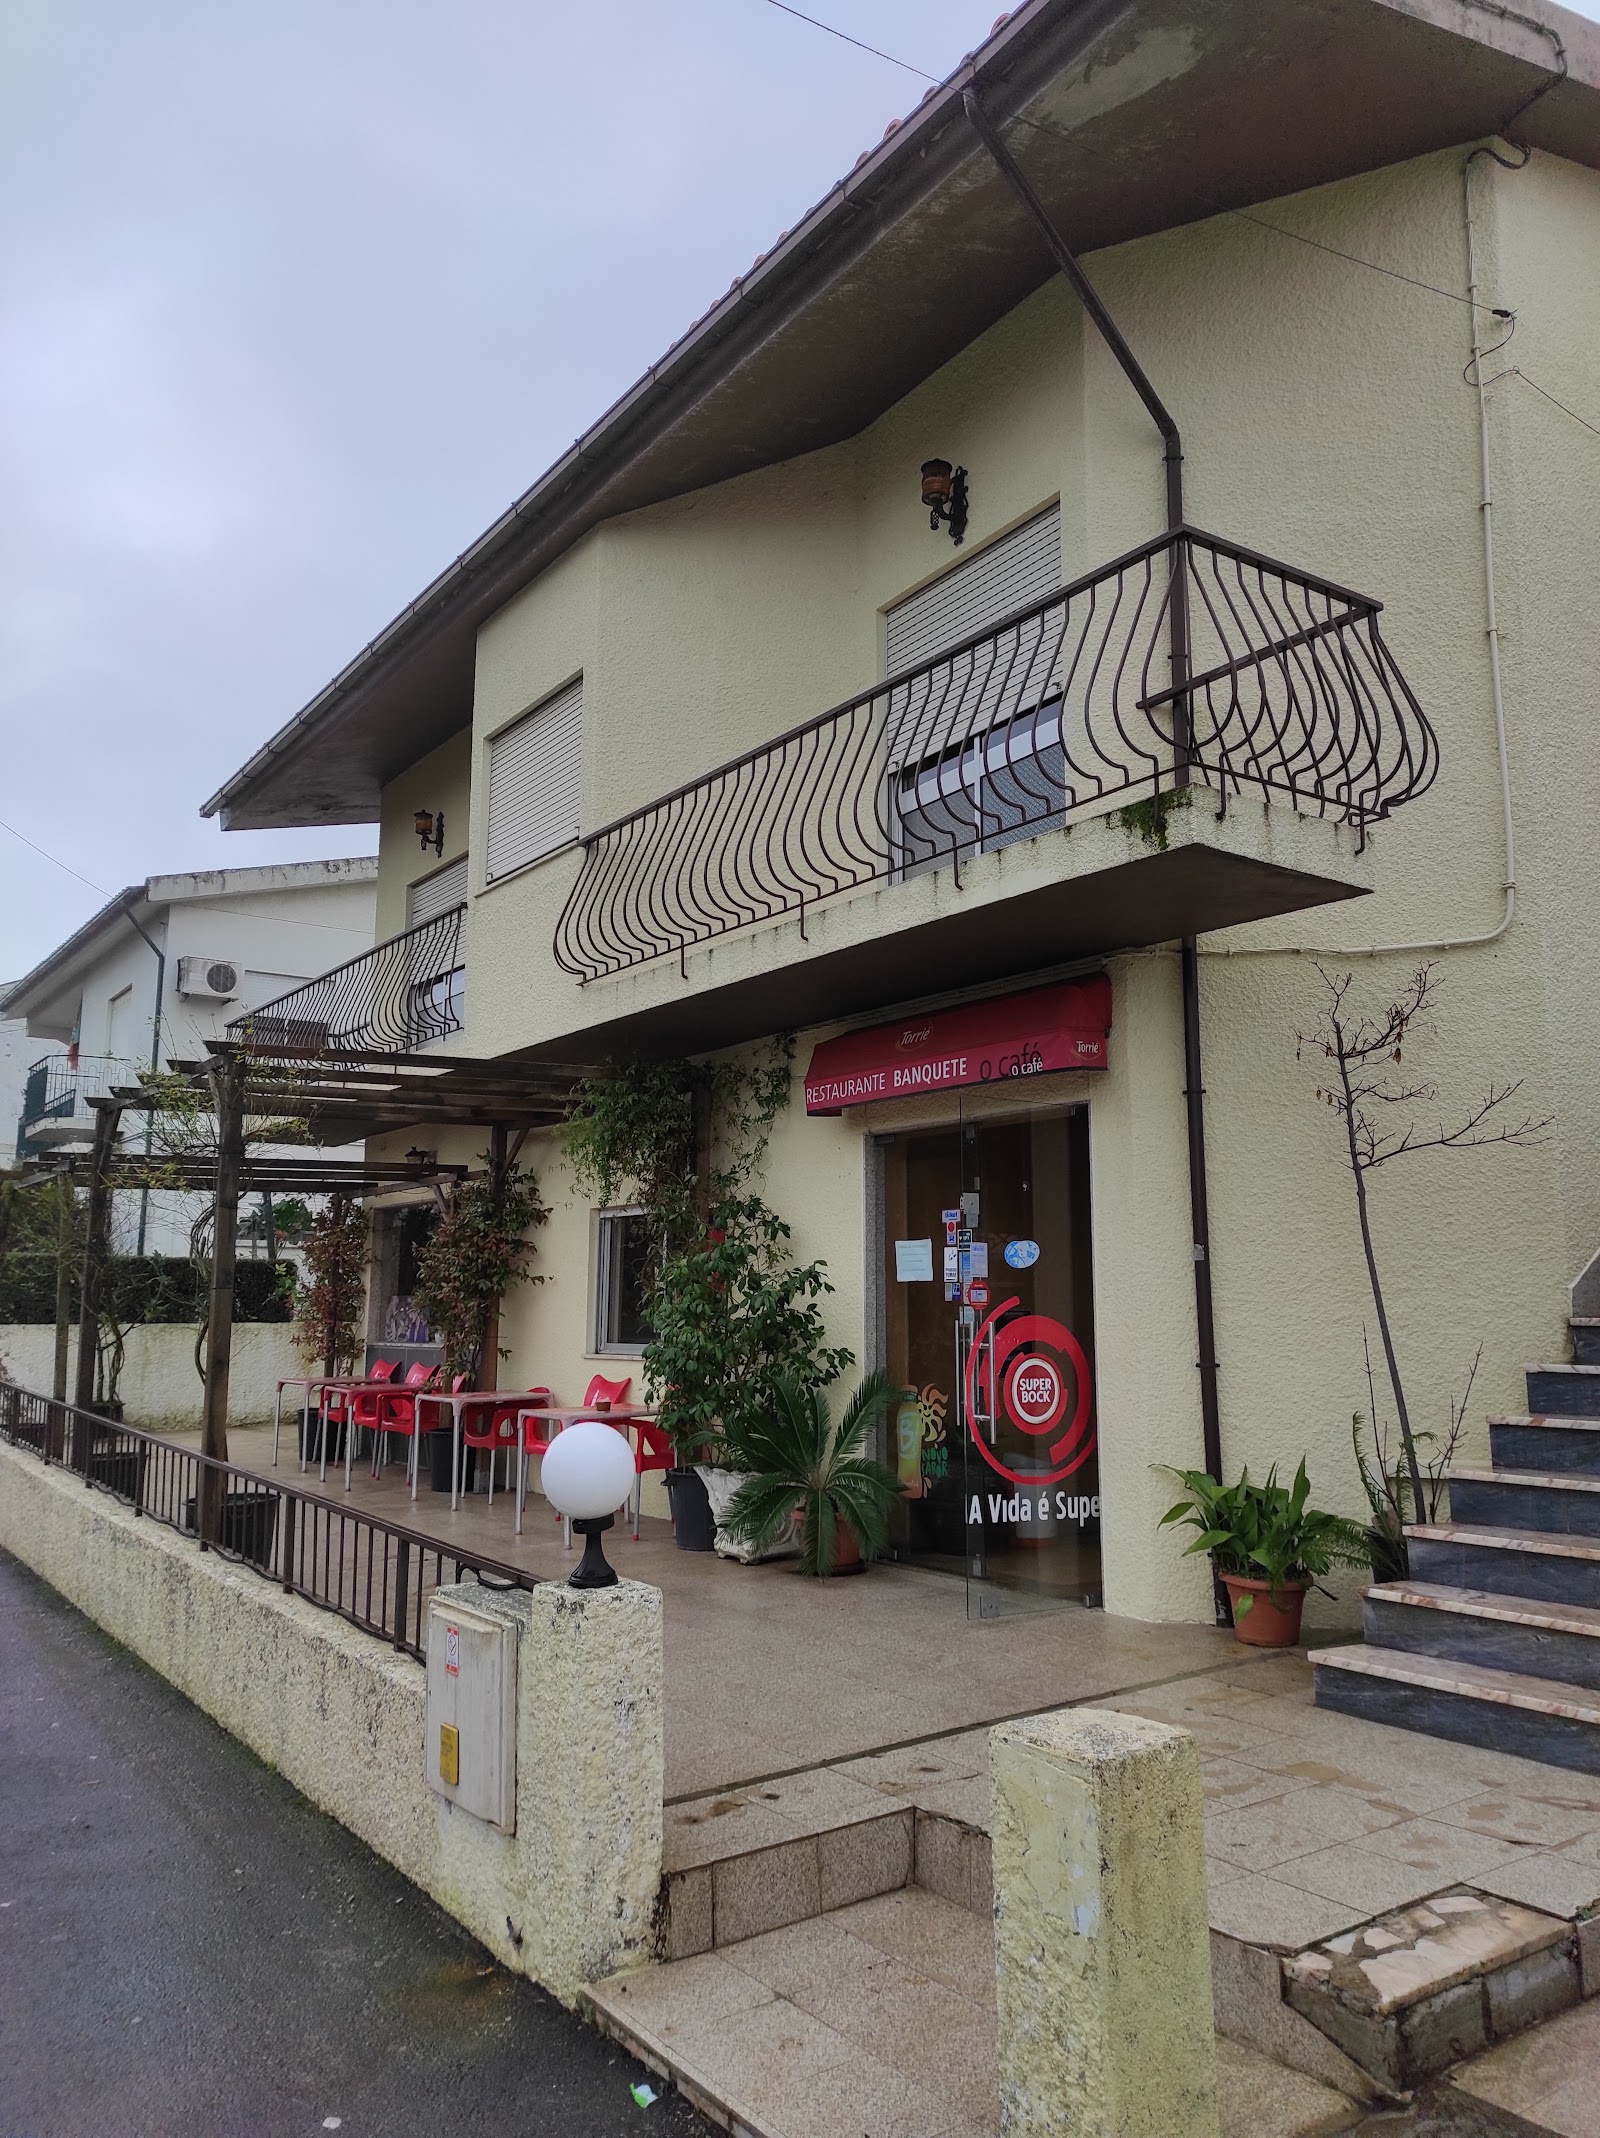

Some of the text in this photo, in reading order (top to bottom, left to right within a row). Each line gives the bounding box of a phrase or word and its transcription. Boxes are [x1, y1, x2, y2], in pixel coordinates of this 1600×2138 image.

[900, 1026, 932, 1046] Torrié
[1076, 1041, 1099, 1054] Torrié
[1011, 1058, 1043, 1076] o café
[806, 1057, 968, 1105] RESTAURANTE BANQUETE
[1019, 1378, 1052, 1391] SUPER
[1021, 1391, 1051, 1404] BOCK
[921, 1446, 949, 1464] NOVO
[968, 1494, 983, 1525] A
[988, 1492, 1032, 1523] Vida
[1037, 1491, 1050, 1521] é
